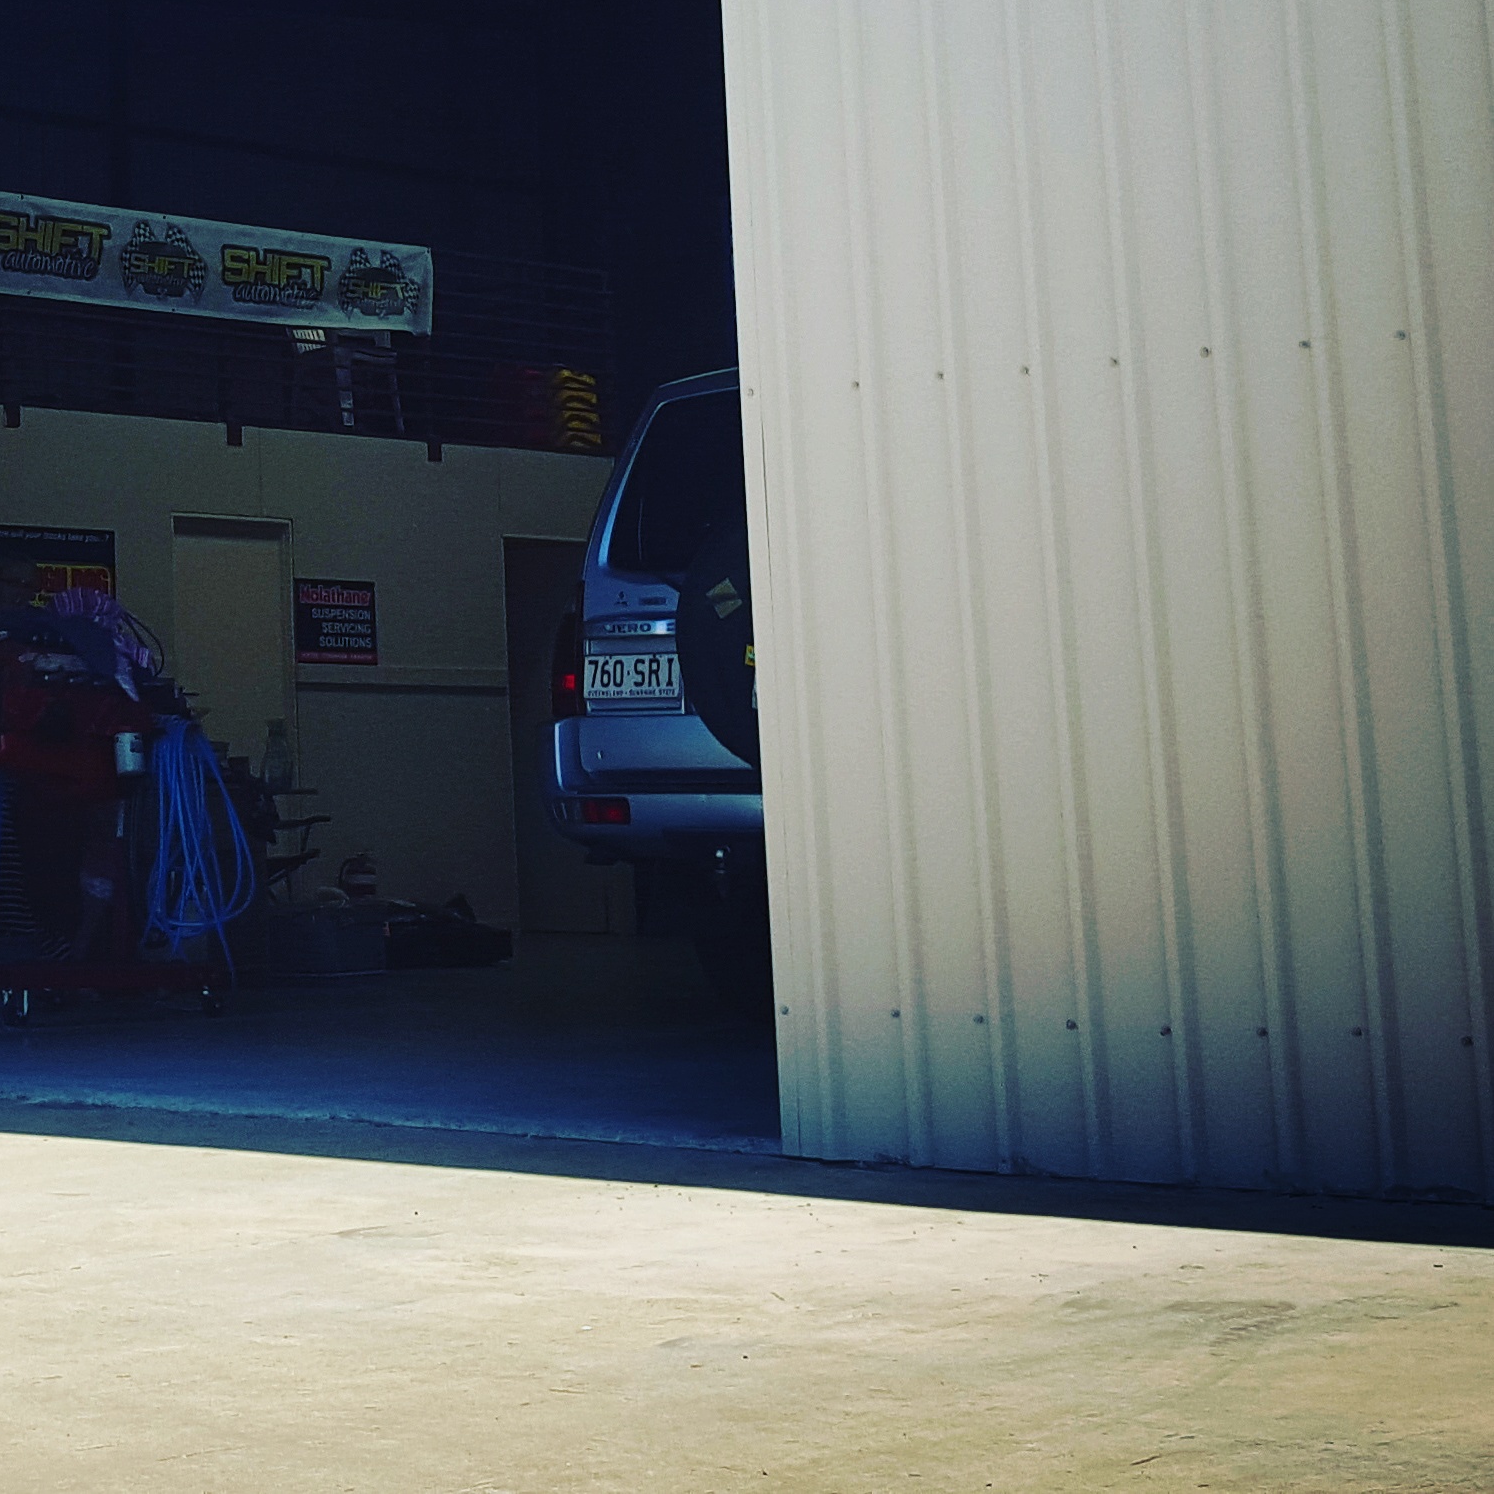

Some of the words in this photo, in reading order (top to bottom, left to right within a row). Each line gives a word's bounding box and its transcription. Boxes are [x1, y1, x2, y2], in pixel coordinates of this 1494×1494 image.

[5, 252, 95, 278] automotive
[130, 253, 195, 278] SHIFT
[224, 248, 329, 292] SHIFT
[299, 584, 370, 606] Nolathane
[311, 607, 371, 620] SUSPENSION
[321, 621, 371, 634] SERVICING
[319, 635, 372, 649] SOLUTIONS
